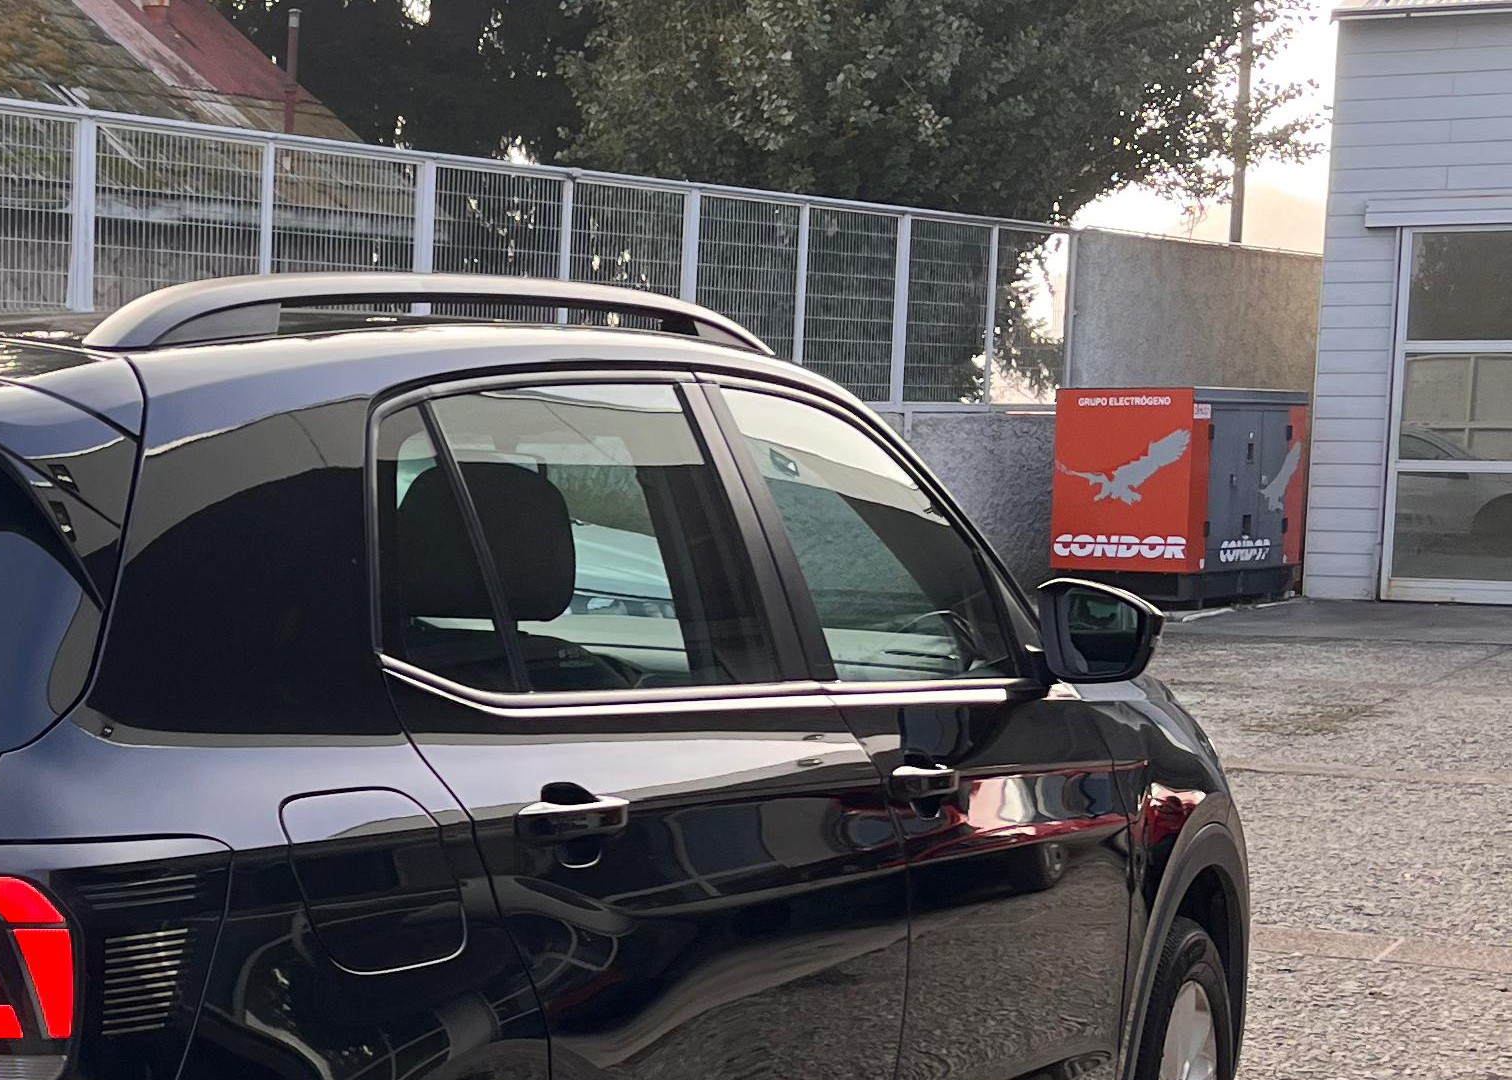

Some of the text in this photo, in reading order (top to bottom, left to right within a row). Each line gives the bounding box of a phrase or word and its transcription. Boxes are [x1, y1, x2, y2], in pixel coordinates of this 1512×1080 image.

[1078, 395, 1171, 406] GRUPO ELECTRÓGENO
[1053, 533, 1187, 559] CONDOR
